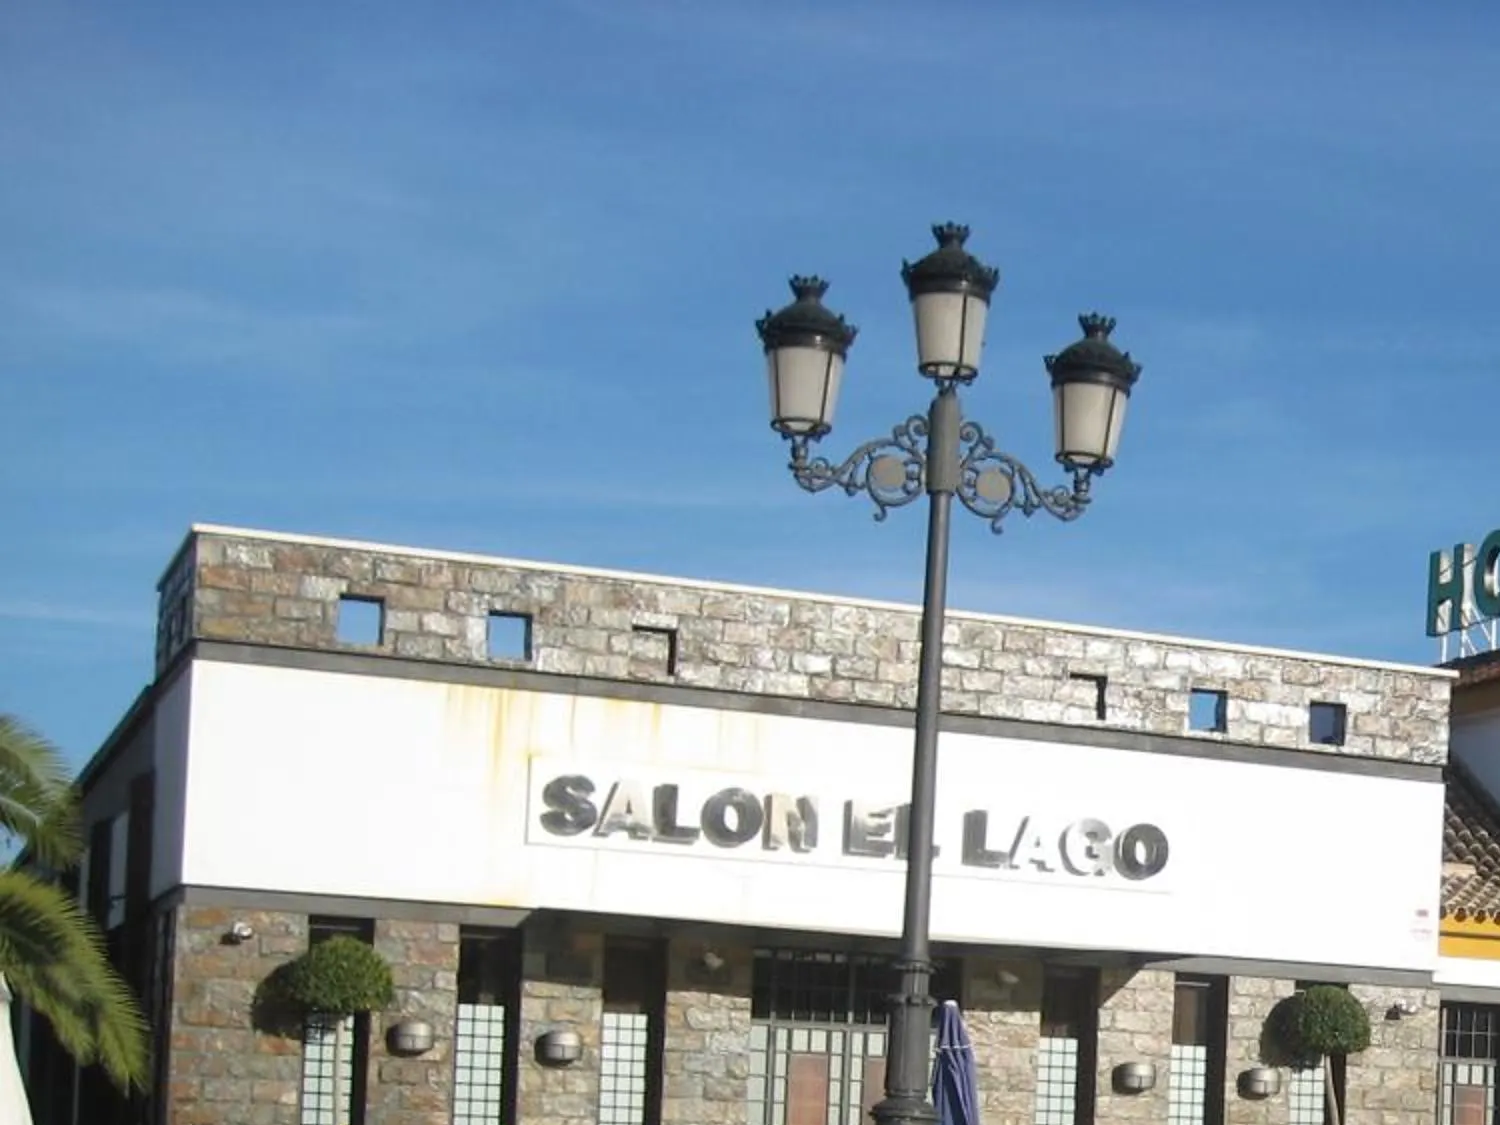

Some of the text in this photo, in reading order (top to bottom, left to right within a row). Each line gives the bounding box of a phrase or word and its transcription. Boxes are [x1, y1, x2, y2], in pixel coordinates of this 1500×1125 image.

[539, 774, 1169, 880] SALON EL LAGO
